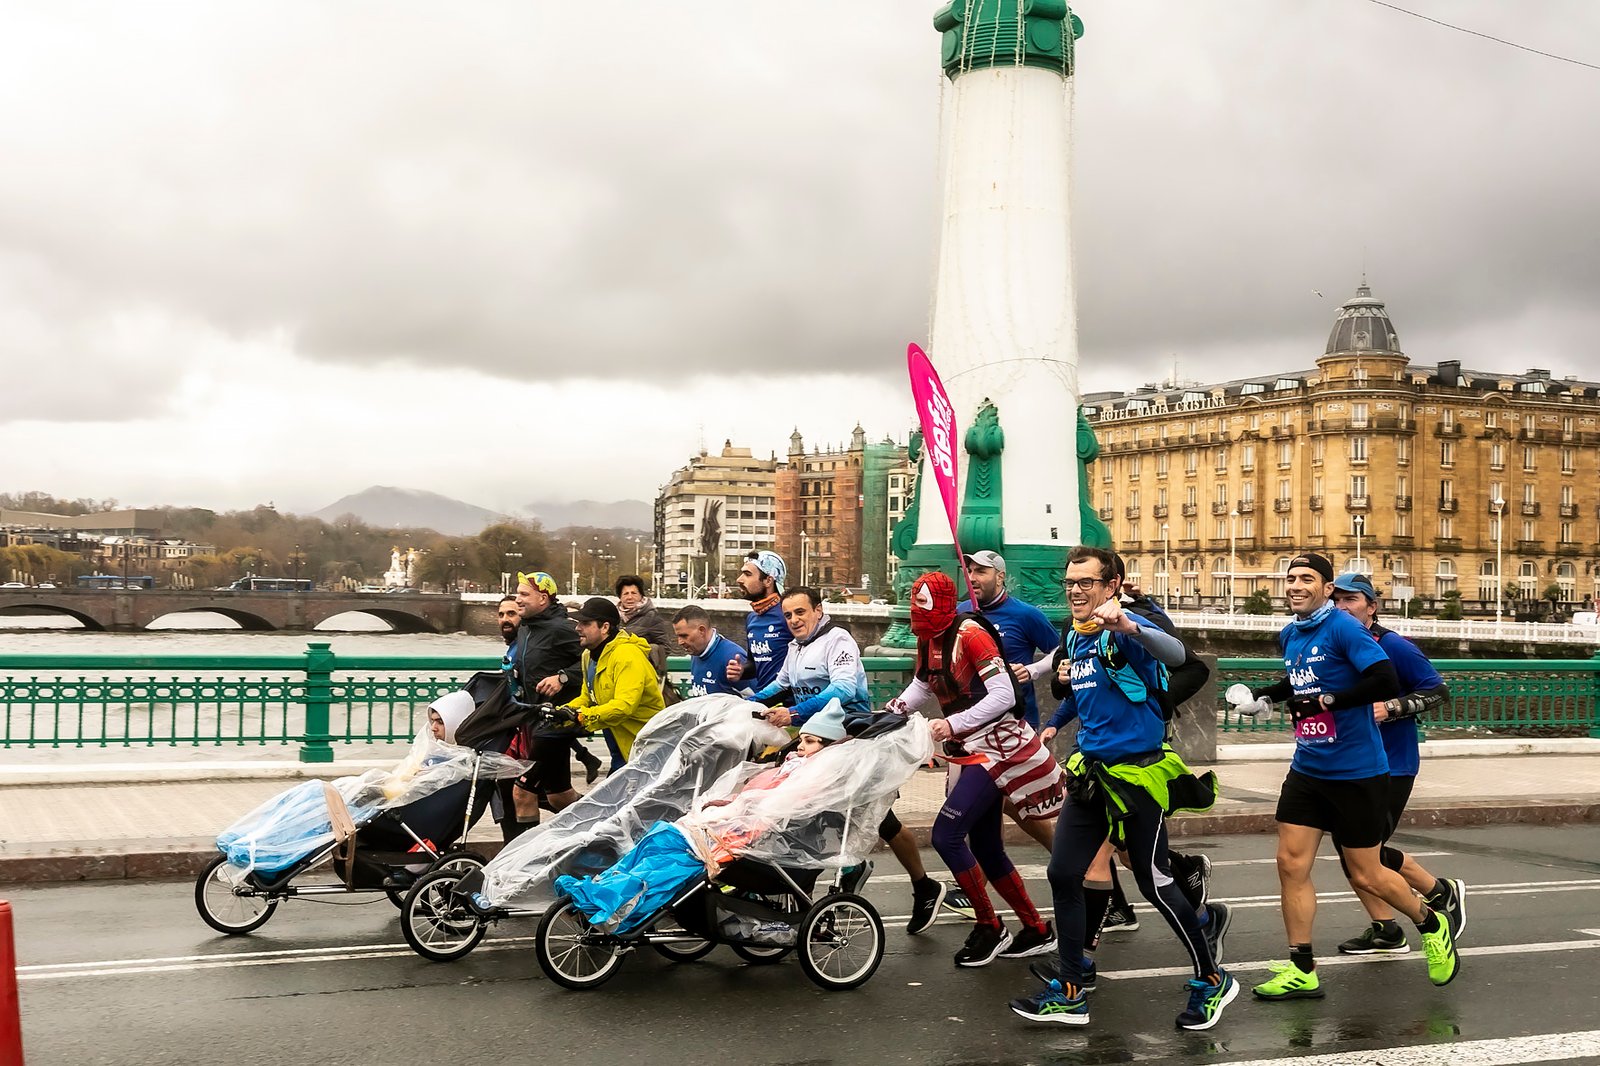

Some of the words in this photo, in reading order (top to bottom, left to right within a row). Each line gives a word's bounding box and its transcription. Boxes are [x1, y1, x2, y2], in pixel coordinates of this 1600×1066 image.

[1100, 408, 1130, 421] HOTEL
[1136, 403, 1169, 417] MARIA
[1175, 396, 1226, 412] CRISTINA
